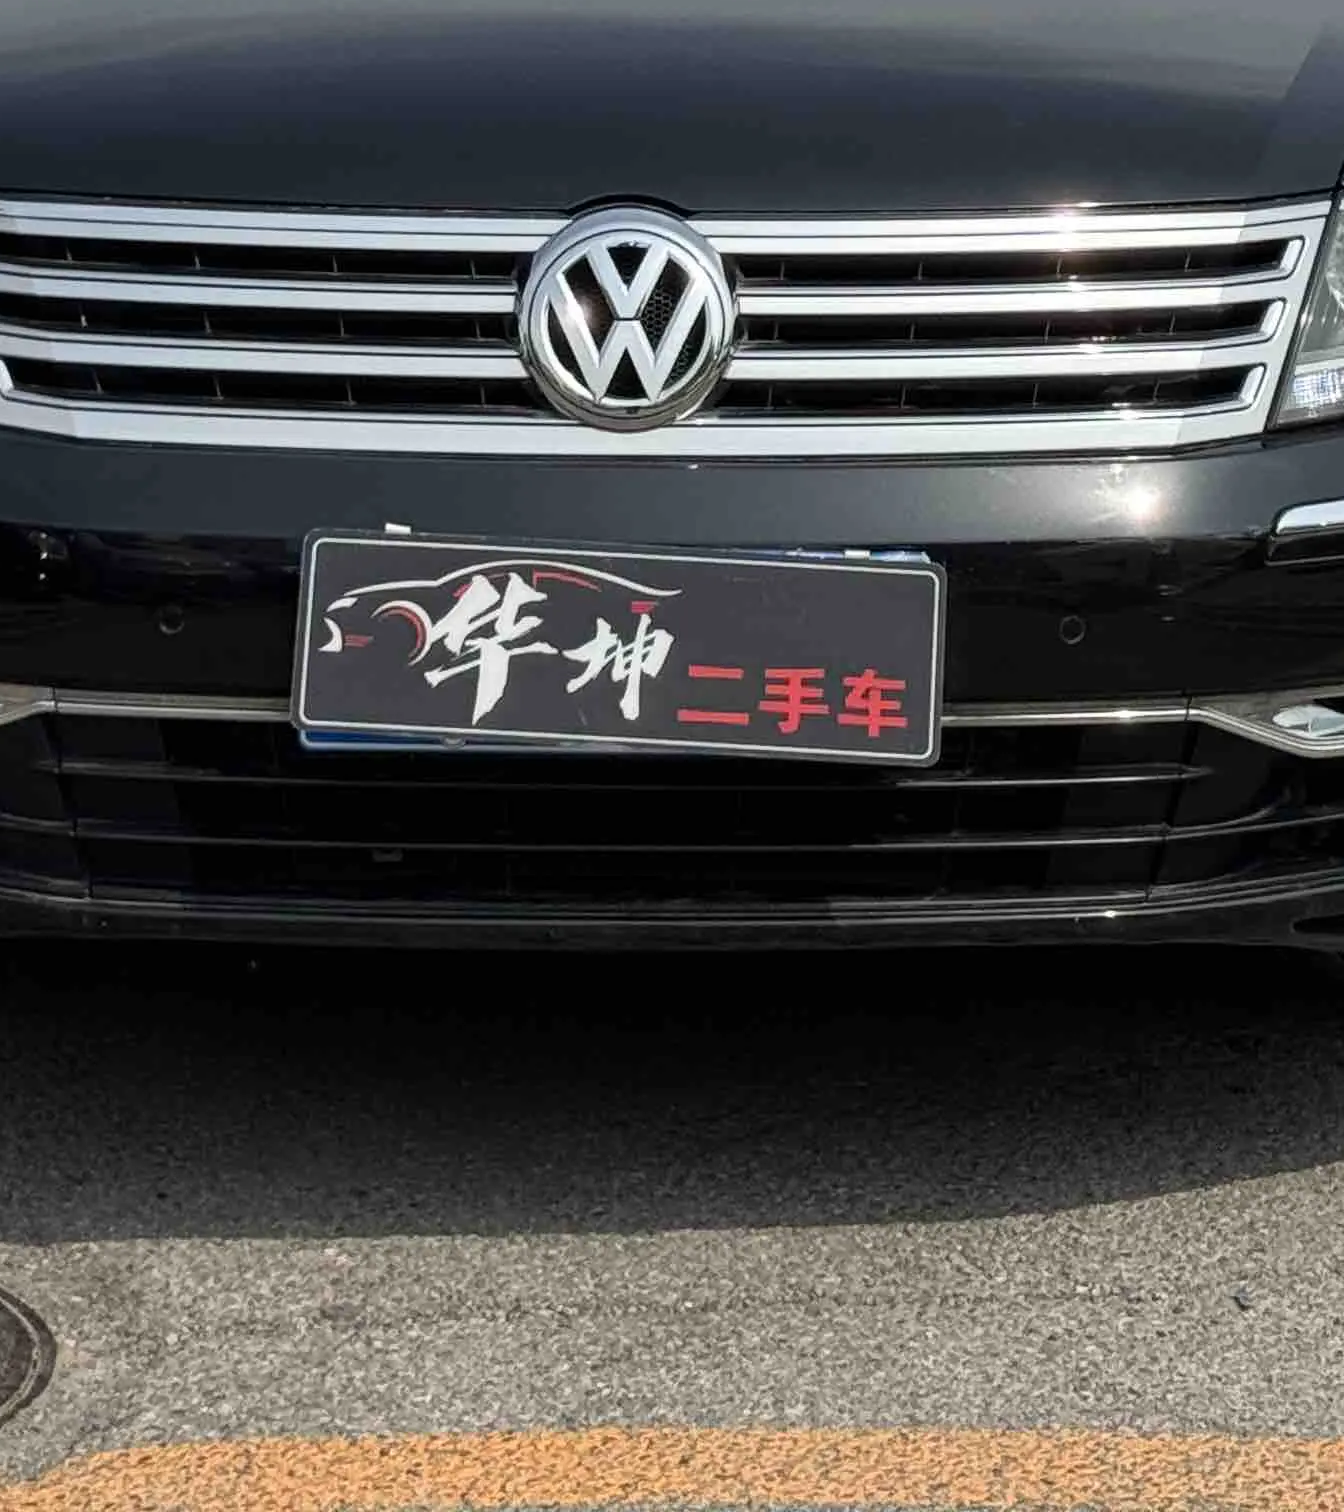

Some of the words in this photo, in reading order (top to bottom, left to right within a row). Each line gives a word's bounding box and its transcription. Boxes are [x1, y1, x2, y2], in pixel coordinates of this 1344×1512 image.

[423, 573, 675, 726] 华坤
[676, 663, 909, 737] 二手车
